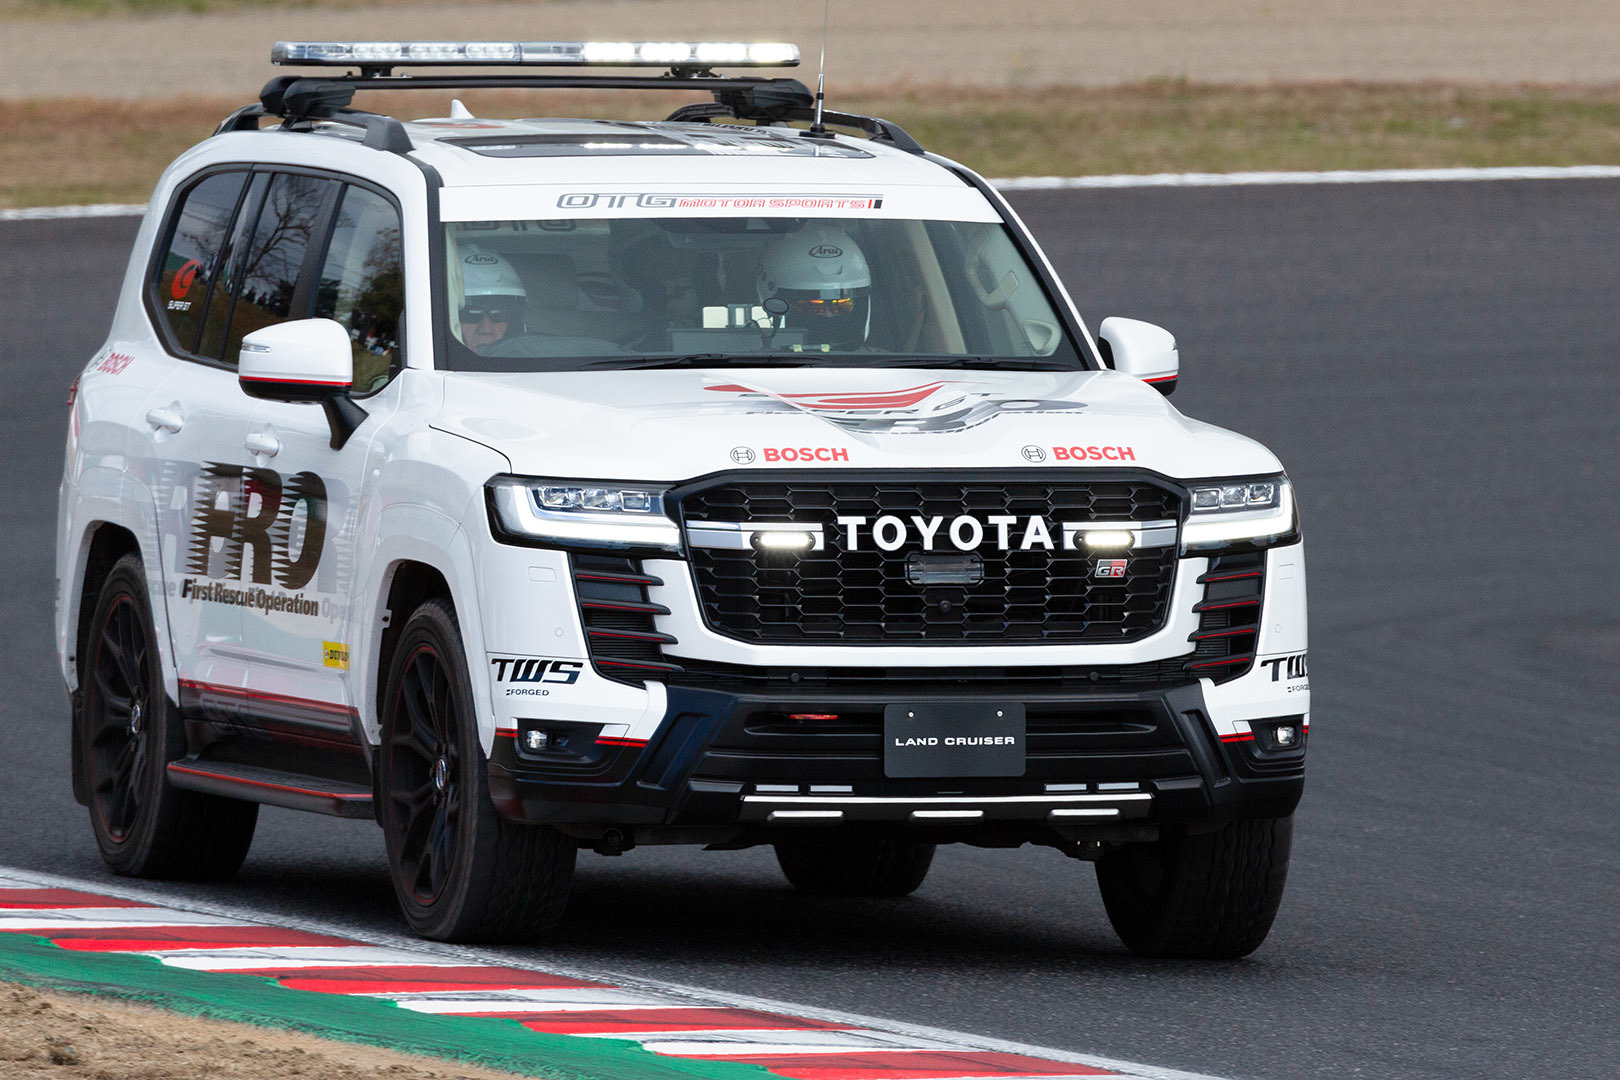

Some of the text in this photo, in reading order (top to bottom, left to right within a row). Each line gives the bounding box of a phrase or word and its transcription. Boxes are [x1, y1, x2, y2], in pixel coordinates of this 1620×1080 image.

[769, 198, 866, 209] SPORTS
[763, 447, 849, 462] BOSCH
[1053, 446, 1136, 461] BOSCH
[837, 515, 1055, 552] TOYOTA
[1097, 566, 1124, 576] GR
[182, 578, 214, 602] First
[214, 582, 254, 608] Rescue
[257, 588, 318, 616] Operation
[491, 658, 583, 685] TWS
[895, 736, 1015, 746] LAND CRUISER
